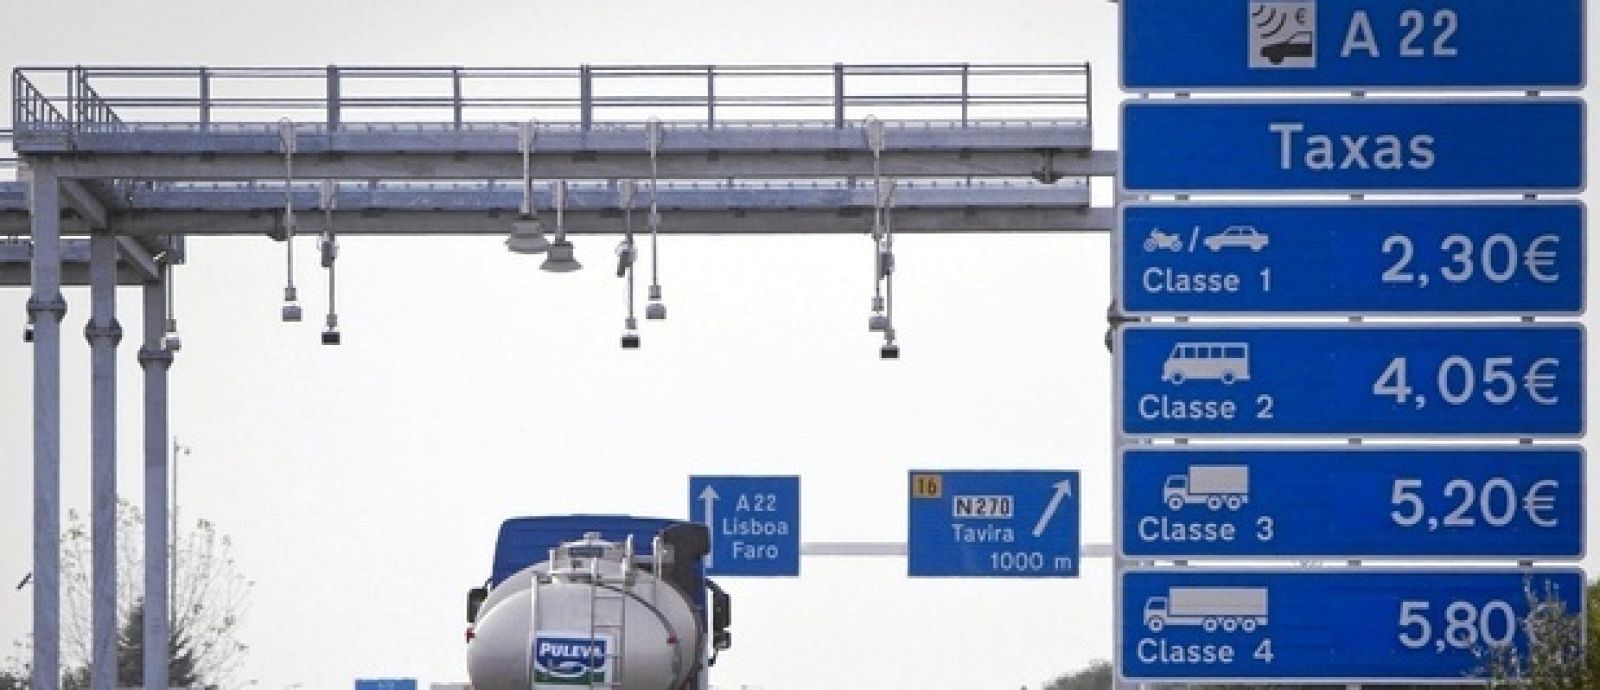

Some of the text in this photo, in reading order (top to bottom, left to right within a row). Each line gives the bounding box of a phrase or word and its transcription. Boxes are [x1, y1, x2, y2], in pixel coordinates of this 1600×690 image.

[1339, 9, 1459, 58] A 22
[1268, 122, 1436, 170] Taxas
[1381, 233, 1561, 289] 2,30€
[1142, 267, 1272, 293] Classe 1
[1372, 355, 1560, 410] 4,05€
[1138, 394, 1274, 420] Classe 2
[917, 476, 937, 496] 16
[1390, 477, 1560, 532] 5,20€
[722, 516, 789, 536] Lisboa
[951, 523, 1015, 543] Tavira
[1138, 516, 1274, 542] Classe 3
[732, 540, 779, 559] Faro
[990, 551, 1072, 571] 1000 m
[1137, 637, 1274, 663] Classe 4
